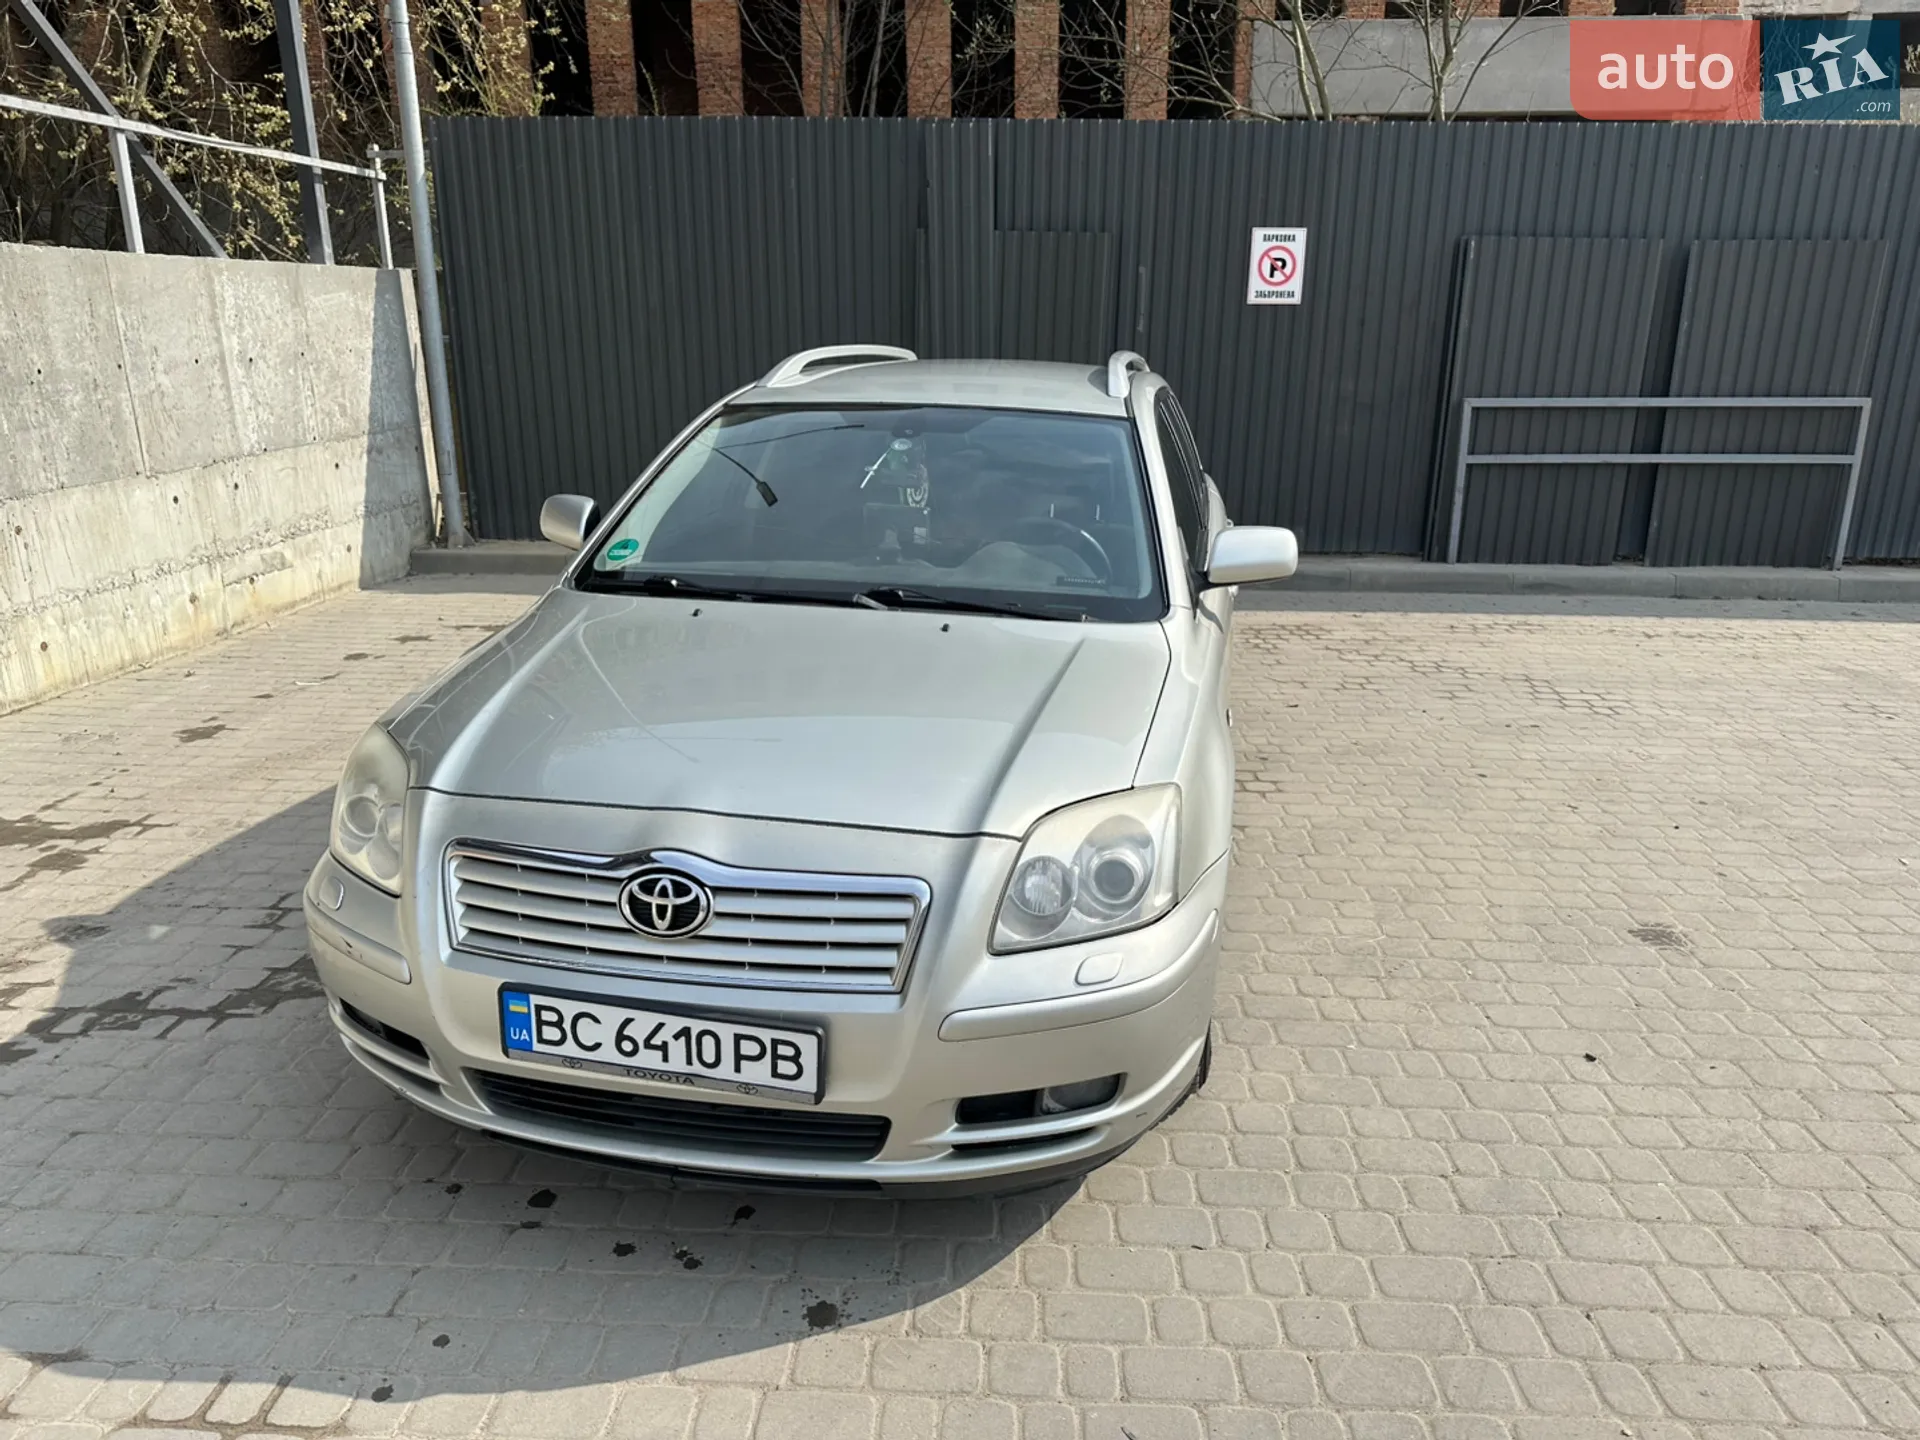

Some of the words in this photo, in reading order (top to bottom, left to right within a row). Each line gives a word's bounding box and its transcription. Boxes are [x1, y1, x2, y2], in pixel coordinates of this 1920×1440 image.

[1263, 234, 1296, 242] ПАРКОВКА
[1254, 290, 1295, 299] ЗАБОРОНЕНА
[510, 1027, 530, 1043] UA
[534, 1003, 602, 1052] BC
[614, 1017, 721, 1069] 6410
[733, 1033, 804, 1081] PB
[624, 1068, 695, 1086] TOYOTA
